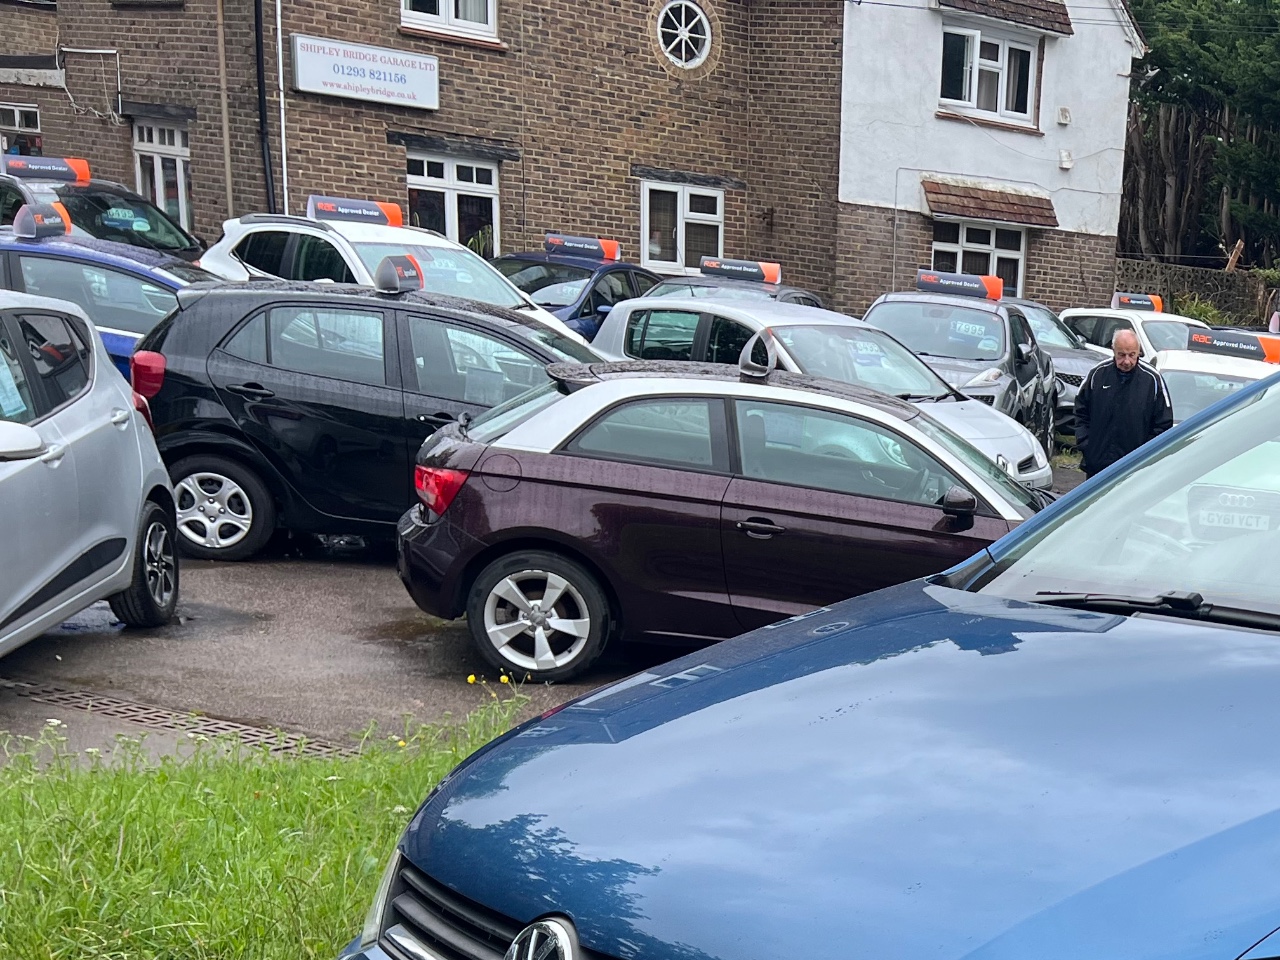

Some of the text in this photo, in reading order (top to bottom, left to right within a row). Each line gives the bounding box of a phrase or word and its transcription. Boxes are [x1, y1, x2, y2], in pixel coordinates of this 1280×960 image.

[300, 42, 435, 72] SHIPLEY BRIDGE GARAGE LTD
[332, 63, 407, 84] 01293 821156
[322, 79, 417, 100] www.shipleybridge.co.uk
[939, 278, 963, 287] Approved
[1213, 339, 1238, 349] Approved
[1239, 342, 1257, 351] Dealer
